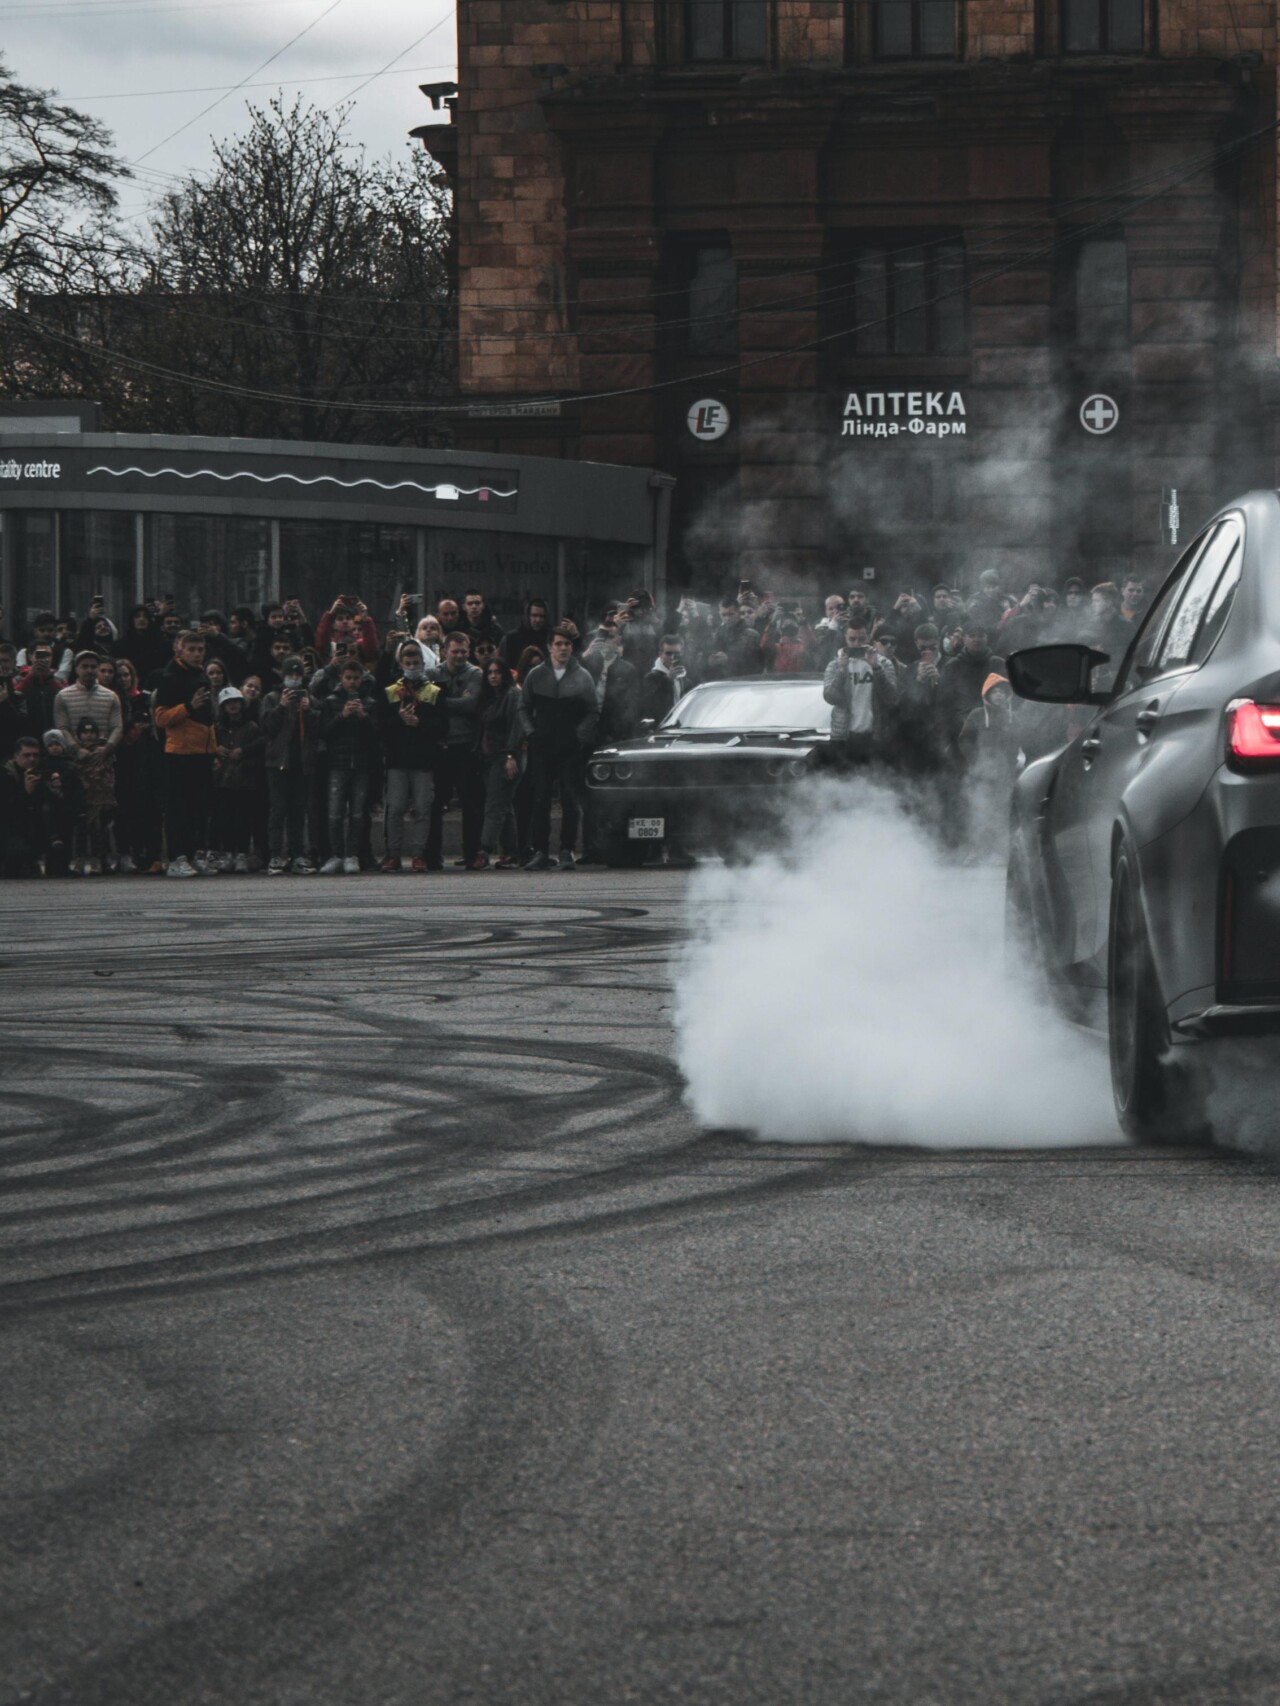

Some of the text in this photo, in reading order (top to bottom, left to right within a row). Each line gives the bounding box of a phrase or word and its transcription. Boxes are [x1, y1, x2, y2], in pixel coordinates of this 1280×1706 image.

[843, 391, 967, 416] АПТЕКА
[696, 405, 721, 433] LF
[841, 418, 967, 438] Лінда-Фарм
[24, 459, 61, 478] centre
[443, 551, 487, 573] Bem
[494, 551, 551, 574] Vindo
[638, 827, 659, 837] 0809
